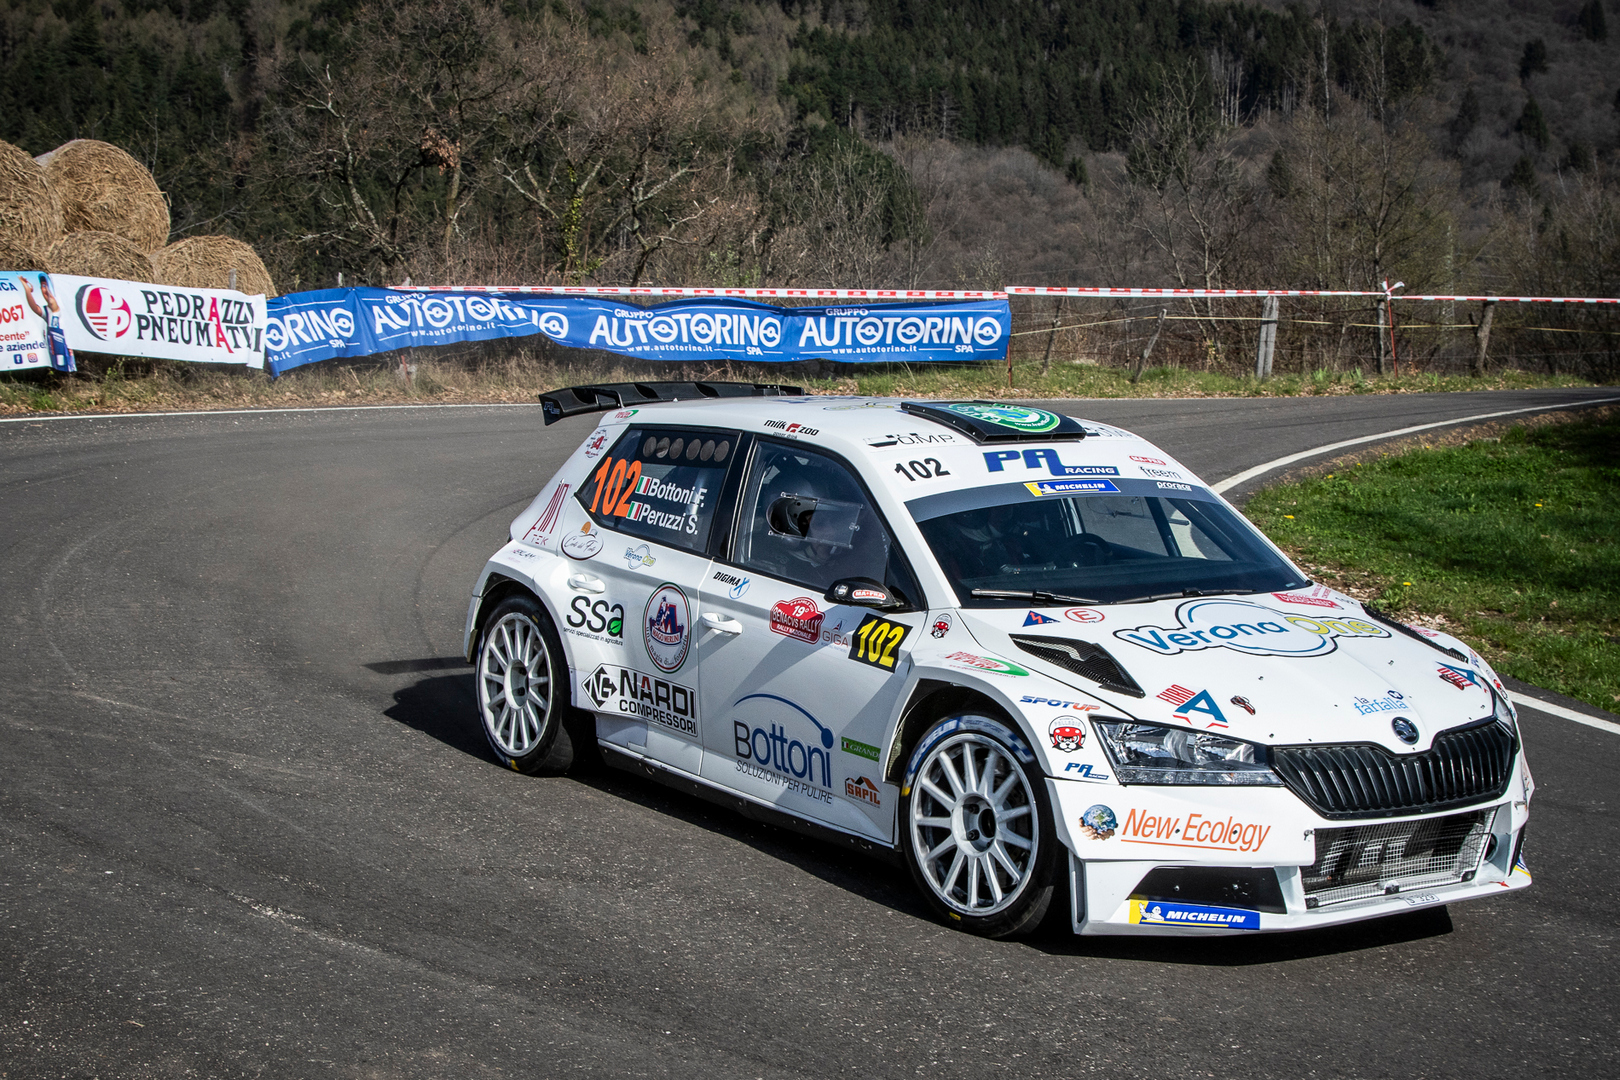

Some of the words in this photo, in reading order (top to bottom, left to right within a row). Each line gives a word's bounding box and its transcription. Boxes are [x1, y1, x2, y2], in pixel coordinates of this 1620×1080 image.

[0, 304, 25, 324] 067
[614, 308, 654, 319] GRUPPO
[825, 308, 869, 316] GRUPPO
[588, 313, 781, 348] AUTOTORINO
[798, 316, 1002, 347] AUTOTORINO
[329, 339, 346, 348] SPA
[627, 344, 713, 352] www.autotorino.it
[746, 346, 763, 355] SPA
[832, 345, 917, 354] www.autotorino.it
[954, 345, 974, 354] SPA
[894, 456, 951, 482] 102
[589, 456, 642, 518] 102
[649, 479, 696, 504] Bottoni
[1054, 482, 1106, 492] MICHELIN
[1156, 481, 1193, 491] prorace
[638, 504, 685, 531] Peruzzi
[685, 514, 699, 535] S.
[800, 619, 821, 634] RALLY
[1127, 620, 1288, 650] Verona
[1287, 615, 1381, 636] One
[822, 630, 849, 648] GIGA
[857, 618, 904, 668] 102
[620, 669, 695, 719] NARDI
[1019, 695, 1100, 711] SPOTUP
[1156, 684, 1196, 706] EURO
[1354, 696, 1369, 704] la
[1354, 697, 1408, 715] farfalla
[619, 699, 696, 734] COMPRESSORI
[734, 719, 833, 789] Bottoni
[736, 759, 781, 786] SOLUZIONI
[782, 776, 800, 793] PER
[800, 784, 833, 805] PULIRE
[847, 783, 881, 805] SAPIL
[1122, 808, 1180, 840] New
[1181, 813, 1271, 853] Ecology
[1166, 910, 1246, 924] MICHELIN
